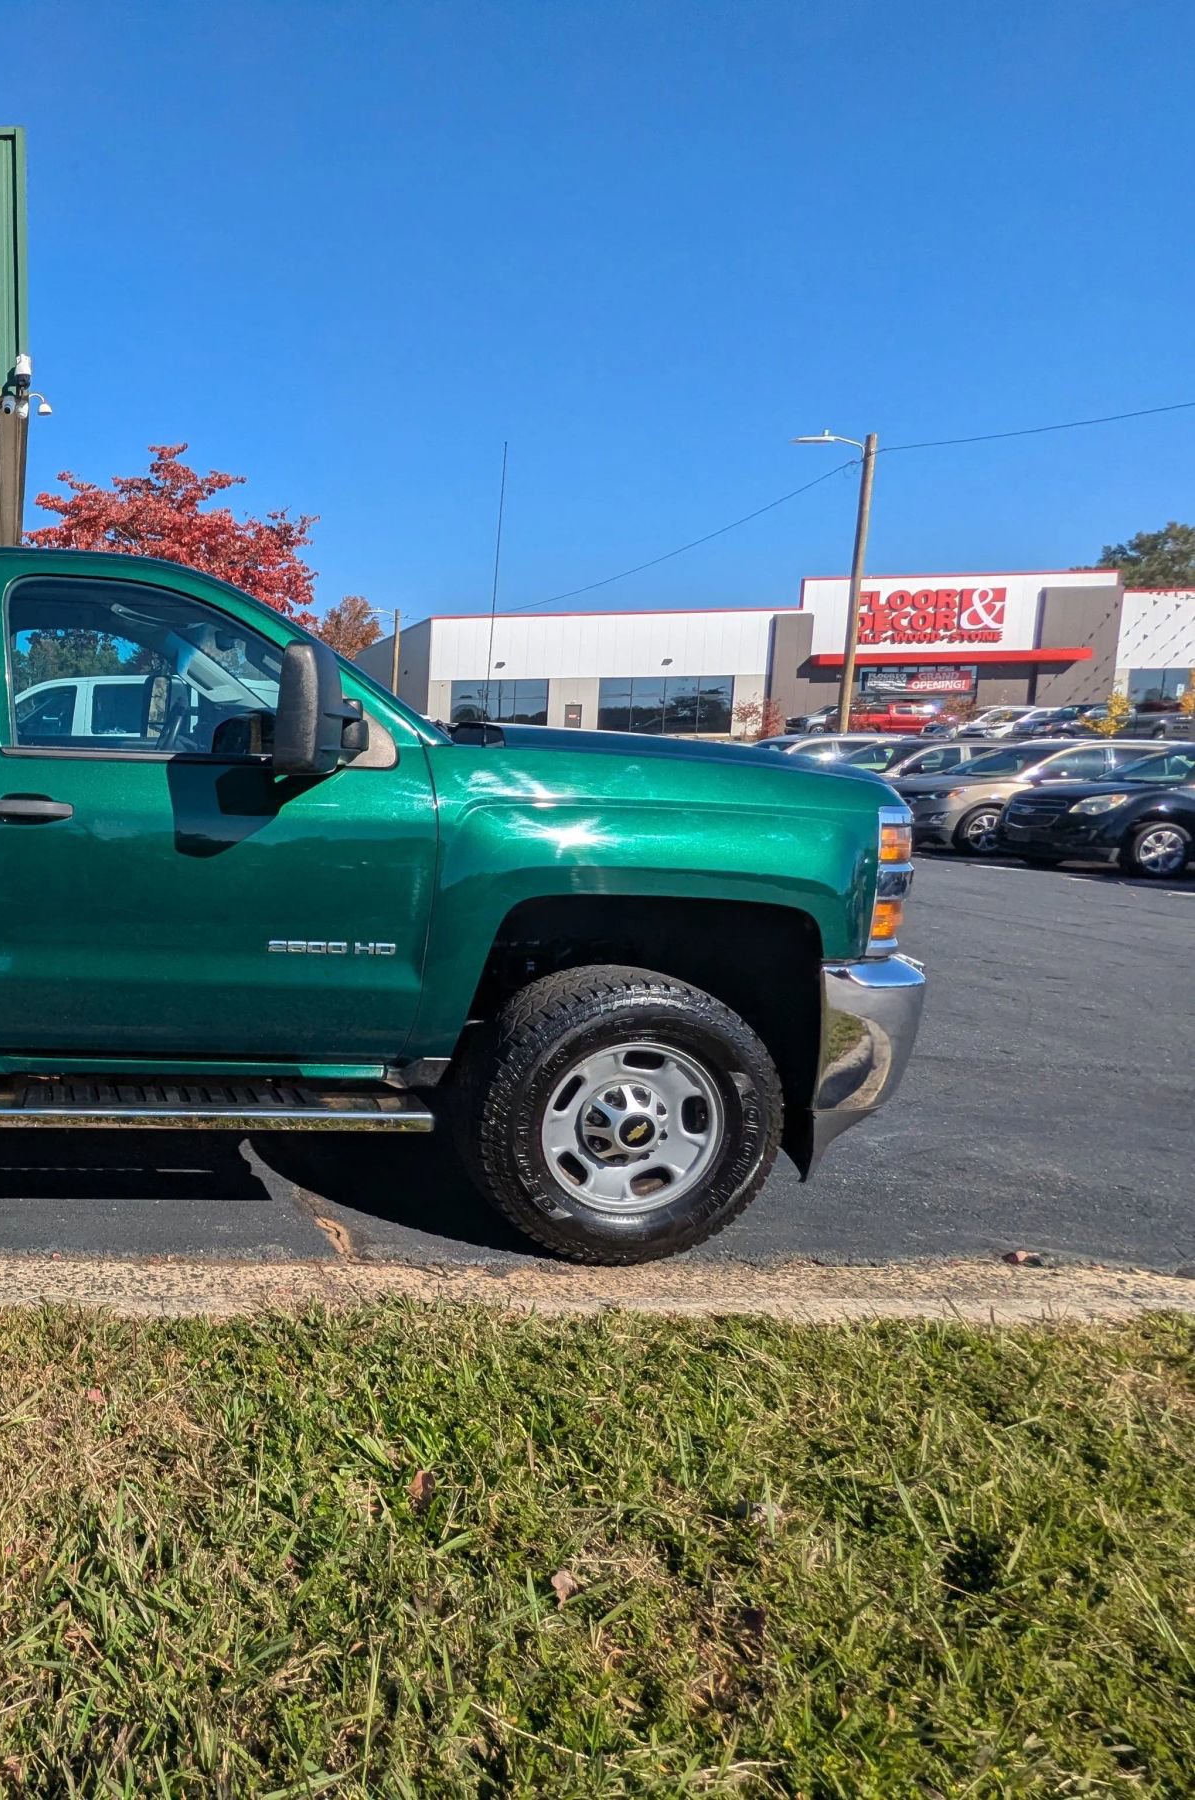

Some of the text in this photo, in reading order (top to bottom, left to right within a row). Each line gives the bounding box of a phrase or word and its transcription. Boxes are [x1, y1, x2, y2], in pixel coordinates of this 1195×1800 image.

[859, 587, 1007, 630] FLOOR &
[857, 610, 956, 632] DECOR
[857, 630, 1003, 644] ILE WOOD STONE
[918, 671, 960, 680] GRAND
[910, 680, 965, 690] OPENING!
[268, 939, 396, 955] 2500 HD
